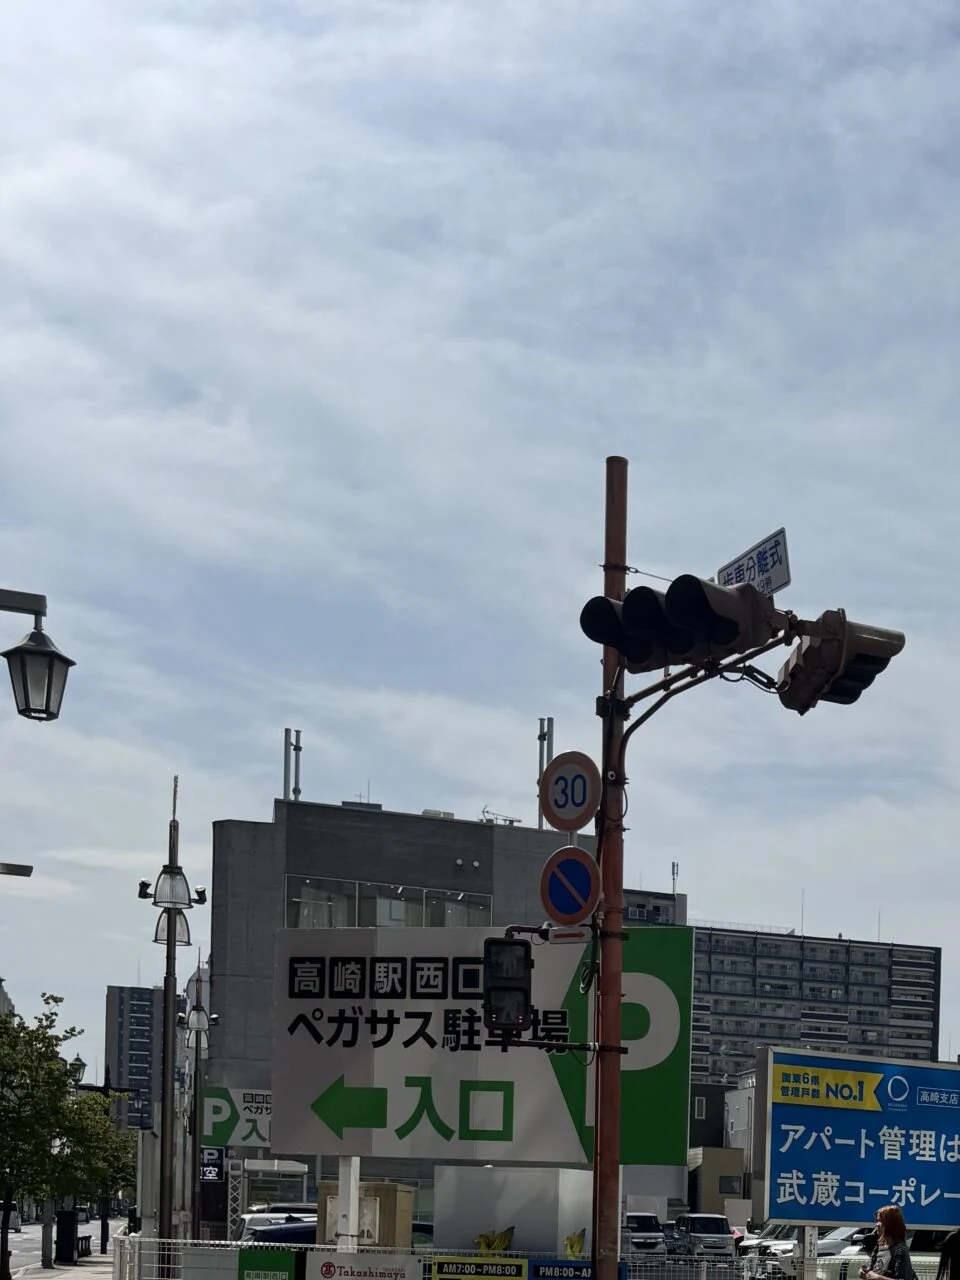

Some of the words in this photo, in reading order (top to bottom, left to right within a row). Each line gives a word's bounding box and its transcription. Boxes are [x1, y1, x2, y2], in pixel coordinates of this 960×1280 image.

[554, 774, 587, 809] 30
[289, 957, 485, 999] 高崎駅西口
[395, 1076, 514, 1141] 入口
[825, 1080, 865, 1102] NO.1
[920, 1090, 960, 1105] 高崎支店
[203, 1097, 231, 1136] P
[241, 1118, 271, 1142] 入
